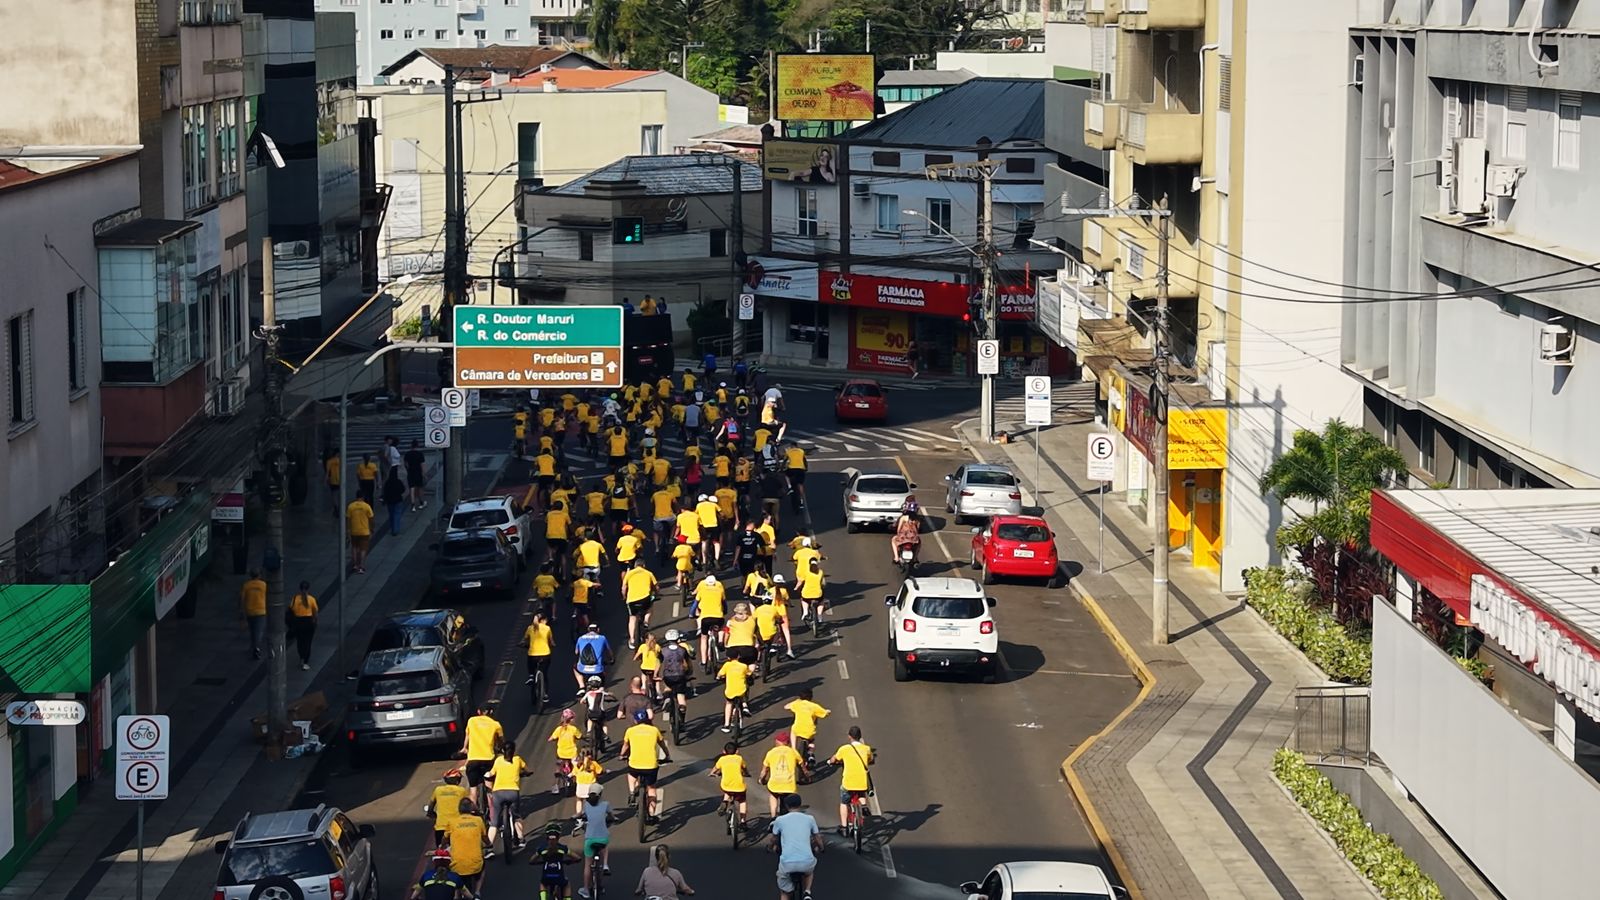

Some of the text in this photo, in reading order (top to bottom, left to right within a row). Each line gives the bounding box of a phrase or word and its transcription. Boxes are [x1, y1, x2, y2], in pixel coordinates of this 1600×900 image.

[784, 87, 822, 97] COMPRA
[792, 99, 817, 109] OURO
[1001, 305, 1012, 313] DO
[477, 314, 575, 324] R. Doutor Maruri
[477, 329, 567, 341] R. do Comércio
[985, 345, 991, 356] E
[533, 353, 589, 364] Prefeitura
[460, 368, 588, 381] Câmara de Vereadores
[1035, 381, 1041, 390] E
[450, 394, 457, 404] E
[435, 432, 441, 441] E
[1097, 442, 1105, 455] E
[136, 768, 149, 786] E
